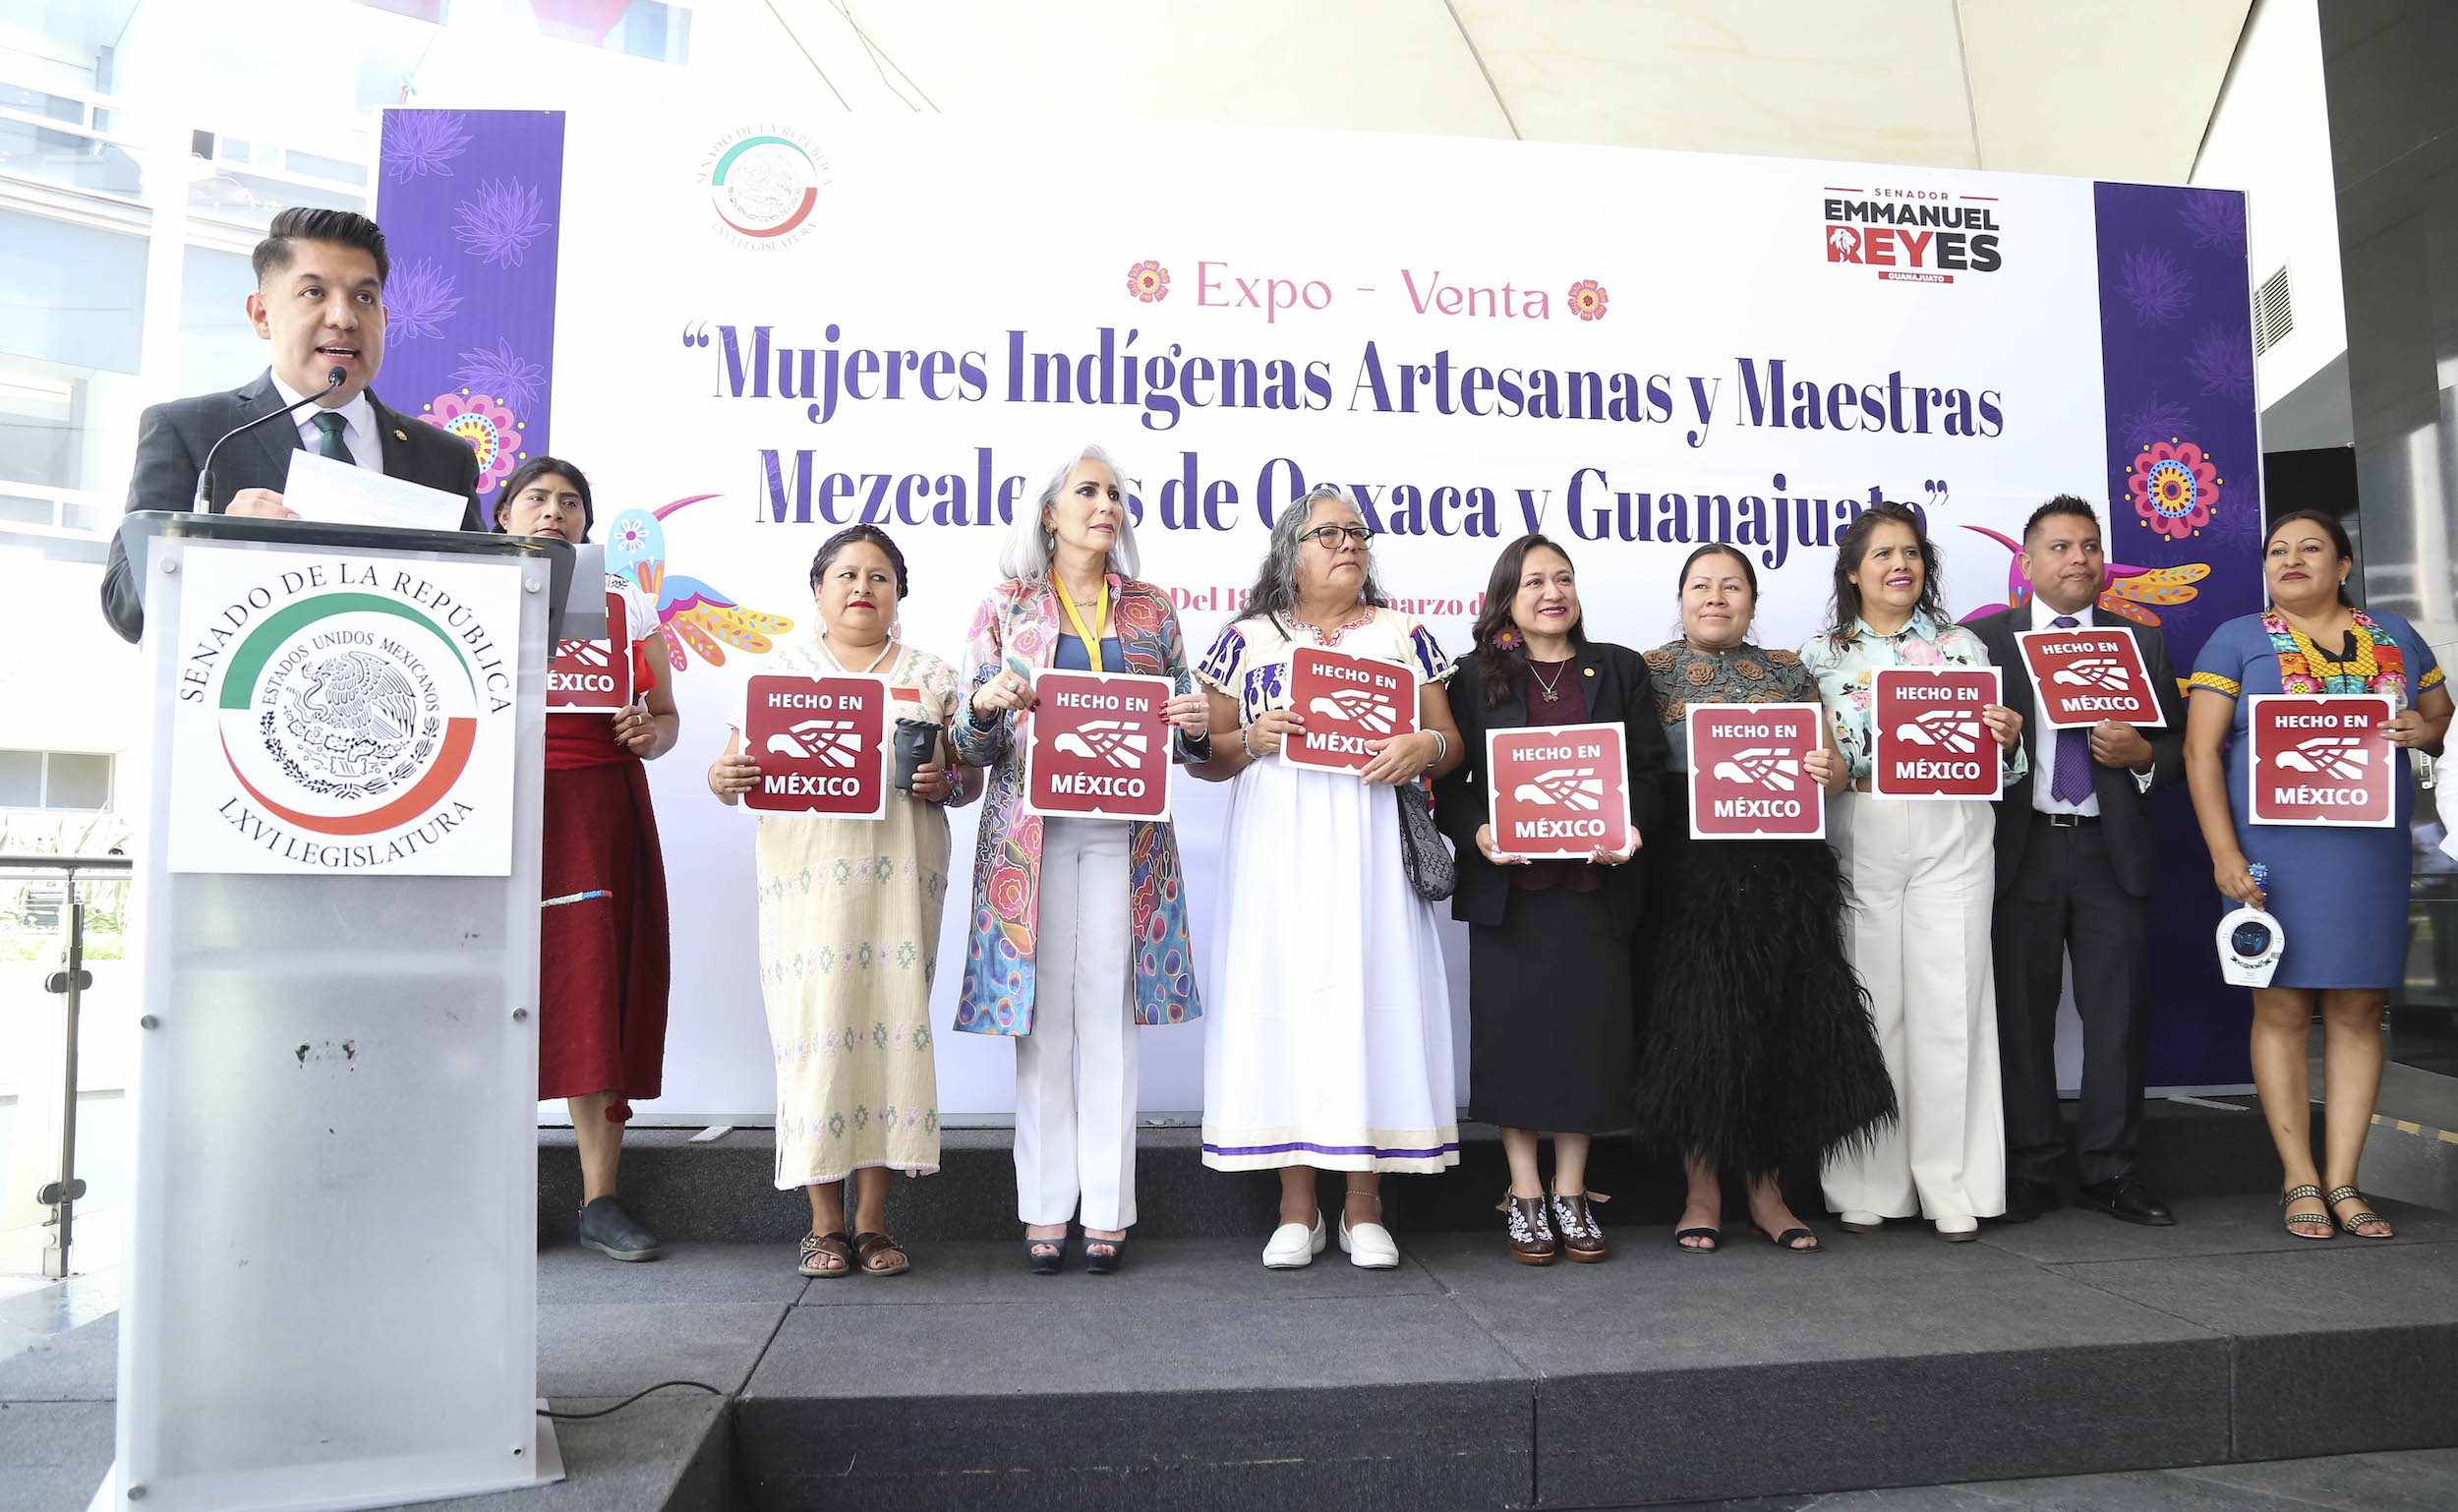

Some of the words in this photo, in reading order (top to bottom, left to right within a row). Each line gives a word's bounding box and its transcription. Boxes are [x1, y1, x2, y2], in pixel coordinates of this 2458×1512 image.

[1874, 188, 1949, 201] SENADOR
[1824, 198, 2000, 231] EMMANUEL
[1825, 224, 2002, 272] REYES
[1888, 272, 1945, 282] GUANAJUATO
[1197, 261, 1332, 324] Expo
[1400, 268, 1550, 320] Venta
[682, 320, 988, 425] “Mujeres
[1004, 326, 1332, 432] Indígenas
[1346, 340, 1673, 423] Artesanas
[1685, 376, 1723, 449] y
[1733, 357, 2004, 438] Maestras
[755, 446, 1143, 529] Mezcales
[1159, 450, 1240, 532] de
[1257, 457, 1501, 538] Oxaca
[1514, 489, 1552, 536] y
[1169, 586, 1217, 611] Del
[180, 587, 271, 703] SENADO
[279, 564, 327, 595] DE
[339, 563, 380, 587] LA
[391, 570, 512, 715] REPÚBLICA
[2041, 642, 2095, 655] HECHO
[2097, 642, 2120, 653] EN
[262, 645, 310, 705] ESTADOS
[312, 630, 375, 650] UNIDOS
[380, 637, 439, 712] MEXICANOS
[1312, 663, 1371, 683] HECHO
[1375, 673, 1397, 690] EN
[768, 692, 833, 710] HECHO
[838, 695, 863, 711] EN
[1056, 691, 1120, 711] HECHO
[1125, 696, 1149, 713] EN
[1896, 686, 1953, 701] HECHO
[1957, 687, 1979, 701] EN
[2060, 694, 2139, 713] MÉXICO
[1711, 725, 1770, 738] HECHO
[1774, 724, 1797, 738] EN
[2275, 715, 2338, 728] HECHO
[2343, 715, 2369, 728] EN
[1512, 745, 1572, 762] HECHO
[1577, 744, 1602, 759] EN
[1896, 758, 1981, 780] MÉXICO
[764, 774, 861, 797] MÉXICO
[1051, 771, 1146, 798] MÉXICO
[2274, 784, 2369, 806] MÉXICO
[1714, 795, 1801, 818] MÉXICO
[217, 796, 284, 851] LXVI
[283, 800, 474, 868] LEGISLATURA
[1514, 816, 1607, 840] MÉXICO
